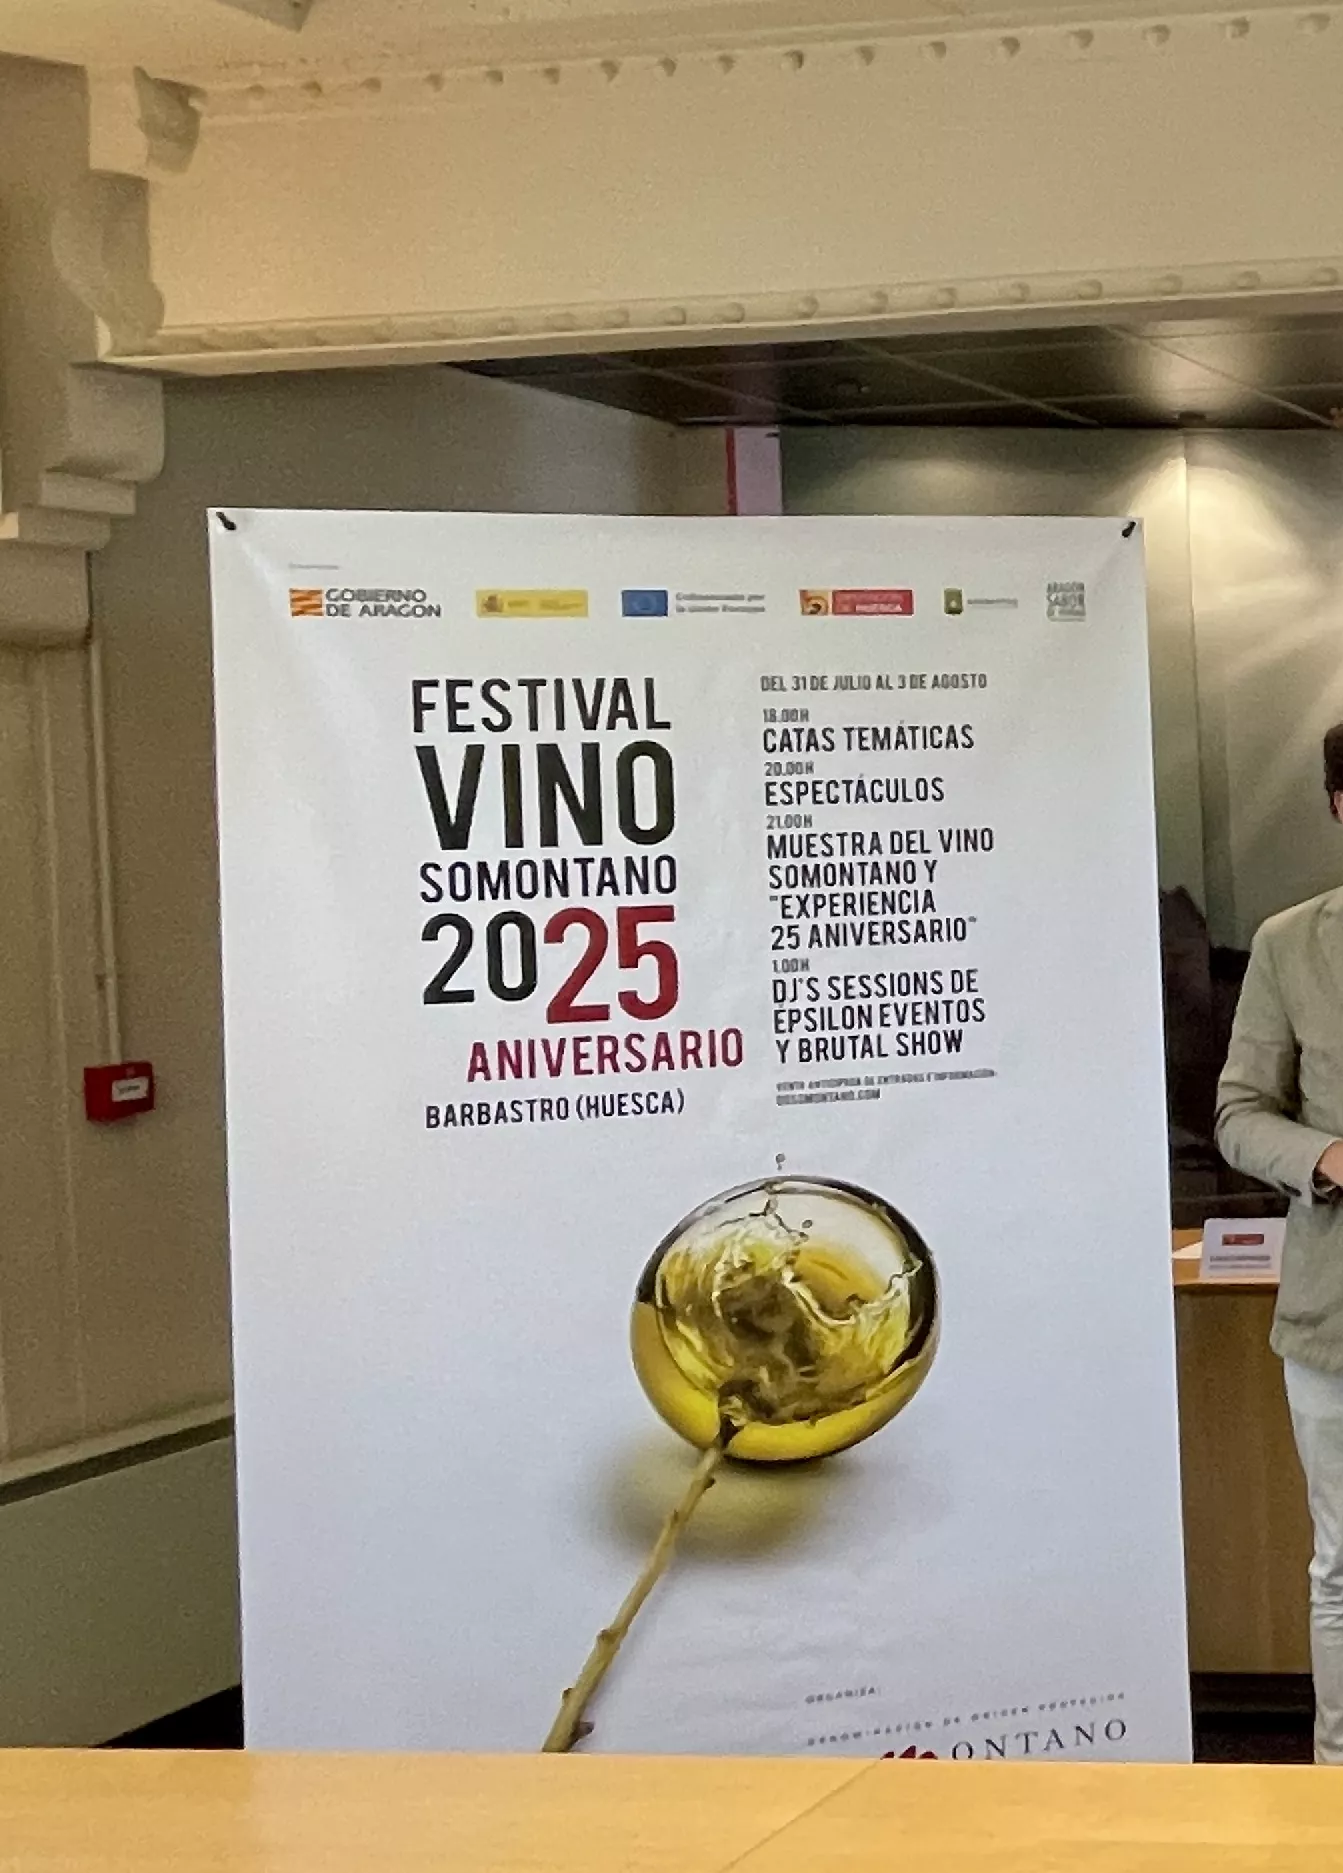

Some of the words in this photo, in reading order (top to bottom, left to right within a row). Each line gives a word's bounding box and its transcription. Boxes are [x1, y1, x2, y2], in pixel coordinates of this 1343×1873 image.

[325, 588, 427, 602] GOBIERNO
[326, 604, 350, 617] DE
[760, 675, 787, 691] DEL
[792, 676, 806, 691] 31
[810, 675, 828, 691] DE
[833, 675, 871, 691] JULIO
[876, 674, 893, 690] AL
[898, 674, 906, 689] 3
[910, 674, 927, 689] DE
[932, 673, 987, 689] AGOSTO
[412, 677, 671, 733] FESTIVAL
[763, 727, 835, 753] CATAS
[843, 719, 974, 750] TEMÁTICAS
[415, 739, 675, 850] VINO
[765, 773, 945, 806] ESPECTÁCULOS
[767, 832, 882, 860] MUESTRA
[890, 830, 932, 854] DEL
[939, 827, 994, 853] VINO
[420, 854, 677, 903] SOMONTANO
[769, 860, 916, 889] SOMONTANO
[924, 860, 938, 883] Y
[771, 925, 800, 950] 25
[421, 905, 679, 1025] 2025
[772, 977, 820, 1003] DJ'S
[828, 970, 943, 1000] SESSIONS
[951, 969, 978, 993] DE
[774, 1002, 873, 1034] ÉPSILON
[879, 998, 986, 1027] EVENTOS
[467, 1027, 744, 1083] ANIVERSARIO
[776, 1039, 790, 1064] Y
[799, 1033, 888, 1063] BRUTAL
[896, 1029, 963, 1057] SHOW
[426, 1096, 570, 1129] BARBASTRO
[576, 1088, 685, 1122] (HUESCA)
[880, 1718, 1127, 1760] ONTANO
